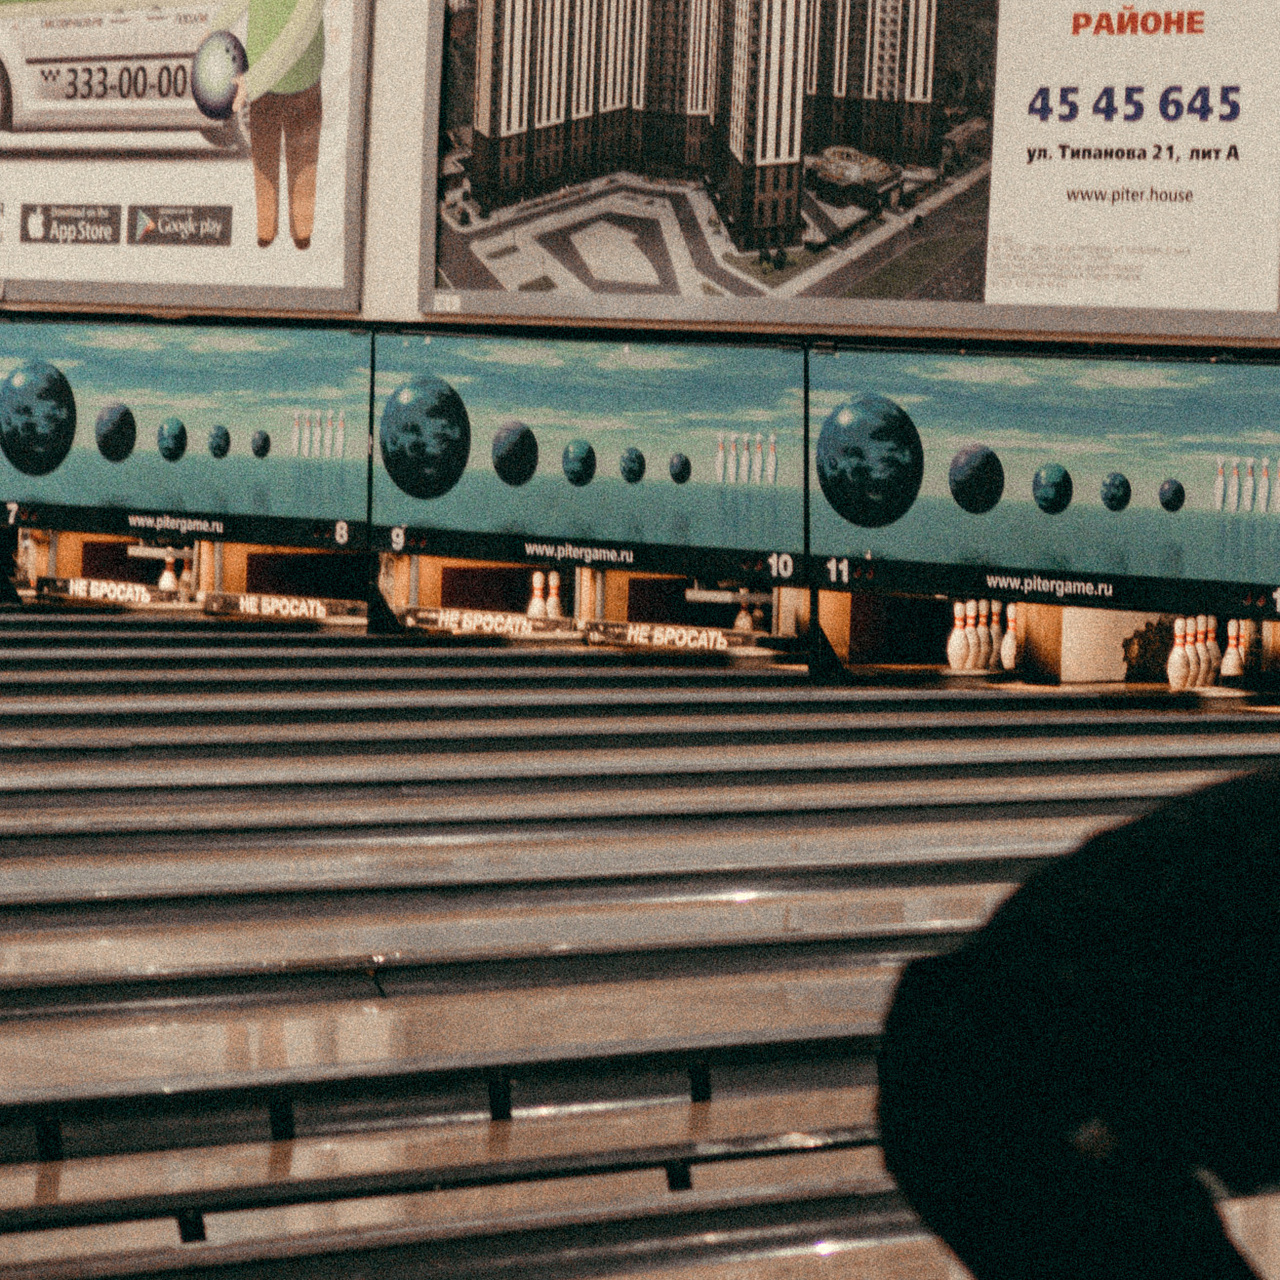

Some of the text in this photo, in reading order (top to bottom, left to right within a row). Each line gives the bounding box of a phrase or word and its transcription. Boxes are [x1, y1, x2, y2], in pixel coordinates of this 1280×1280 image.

[1070, 4, 1206, 37] РАЙОНЕ
[65, 64, 188, 100] 333-00-00
[1027, 84, 1242, 123] 45 45 645
[1026, 146, 1053, 166] ул.
[1057, 142, 1149, 162] Типанова
[1188, 146, 1222, 162] лит
[1226, 143, 1240, 162] А
[1065, 185, 1195, 206] www.piter.house
[50, 220, 113, 243] App Store
[157, 215, 197, 240] Google
[6, 502, 20, 525] 7
[127, 514, 226, 535] www.pitergame.ru
[334, 519, 349, 545] 8
[389, 526, 406, 551] 9
[524, 541, 635, 564] www.pitergame.ru
[766, 552, 794, 578] 10
[825, 556, 850, 584] 11
[69, 577, 152, 604] НЕ БРОСАТЬ
[985, 573, 1114, 598] www.pitergame.ru
[239, 595, 327, 619] НЕ БРОСАТЬ
[437, 609, 533, 637] НЕ БРОСАТЬ
[626, 624, 729, 650] НЕ БРОСАТЬ
